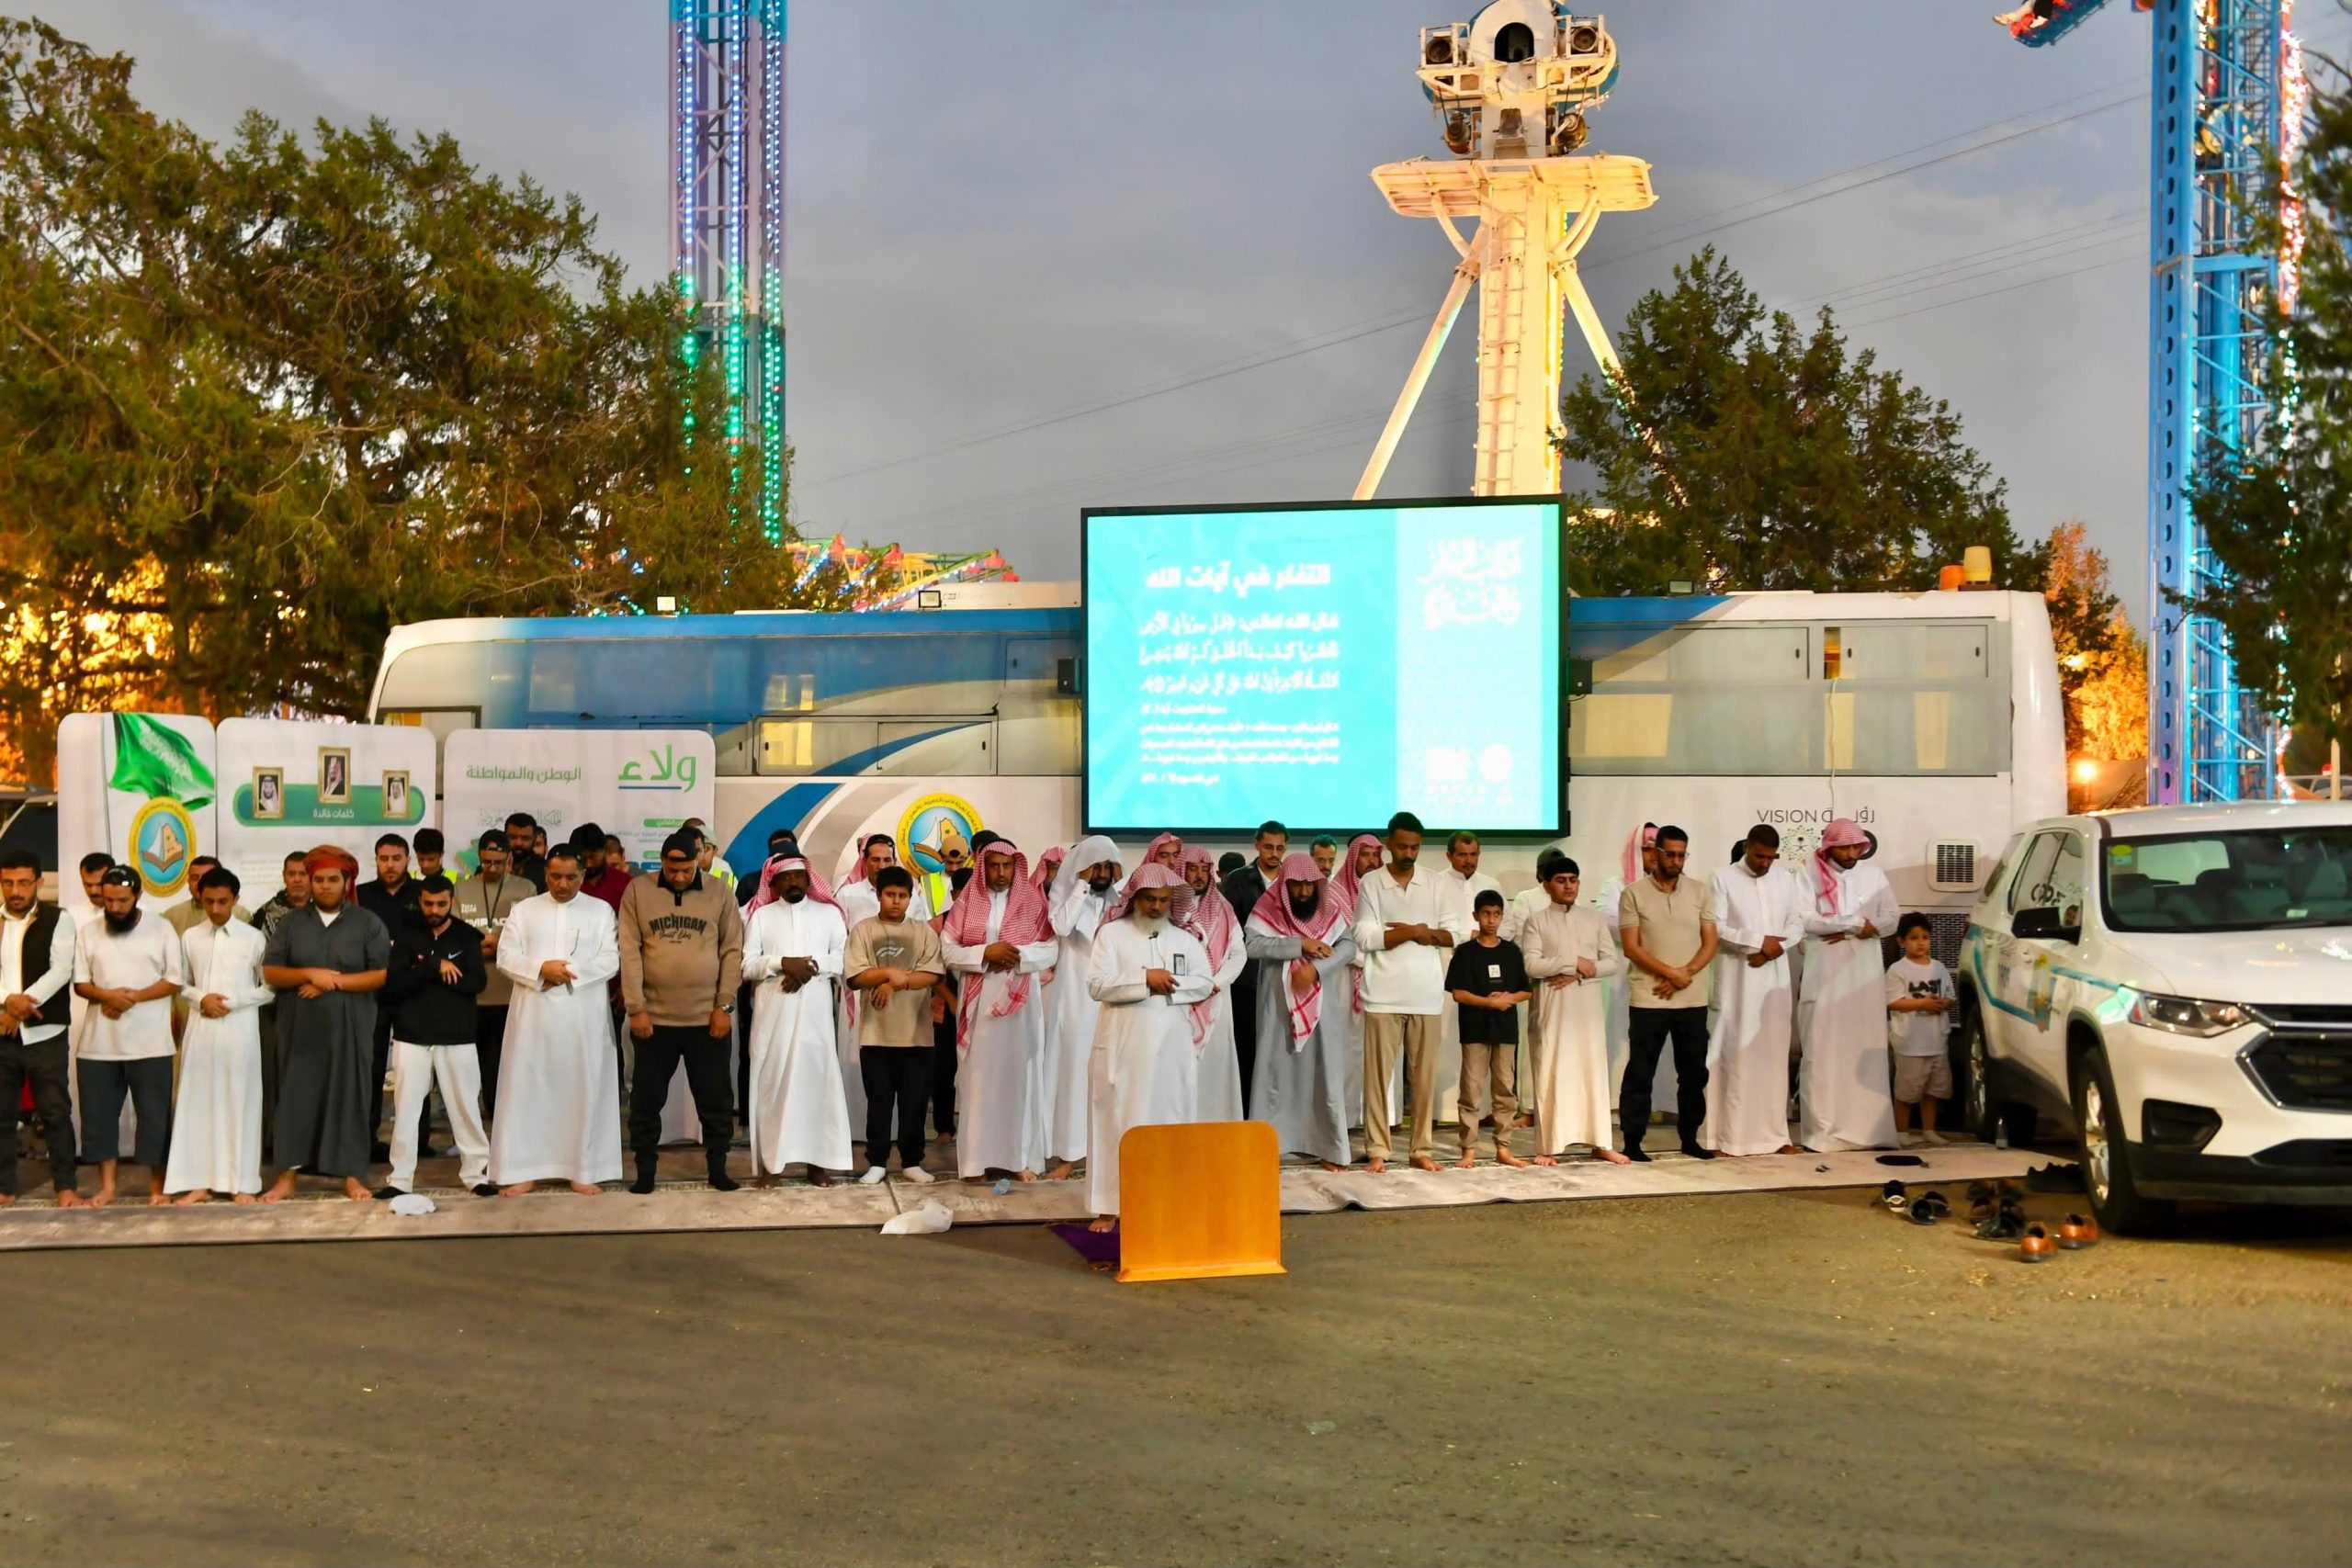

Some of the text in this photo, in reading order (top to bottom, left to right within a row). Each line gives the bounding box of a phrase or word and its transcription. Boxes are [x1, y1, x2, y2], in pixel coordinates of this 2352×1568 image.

[1147, 560, 1331, 598] التفكر في آيات الله
[467, 764, 582, 784] الوطن والمواطنة
[618, 744, 696, 793] ولاء
[313, 807, 355, 818] كلمات خالدة
[1757, 809, 1817, 823] VISION
[649, 913, 707, 936] MICHIGAN
